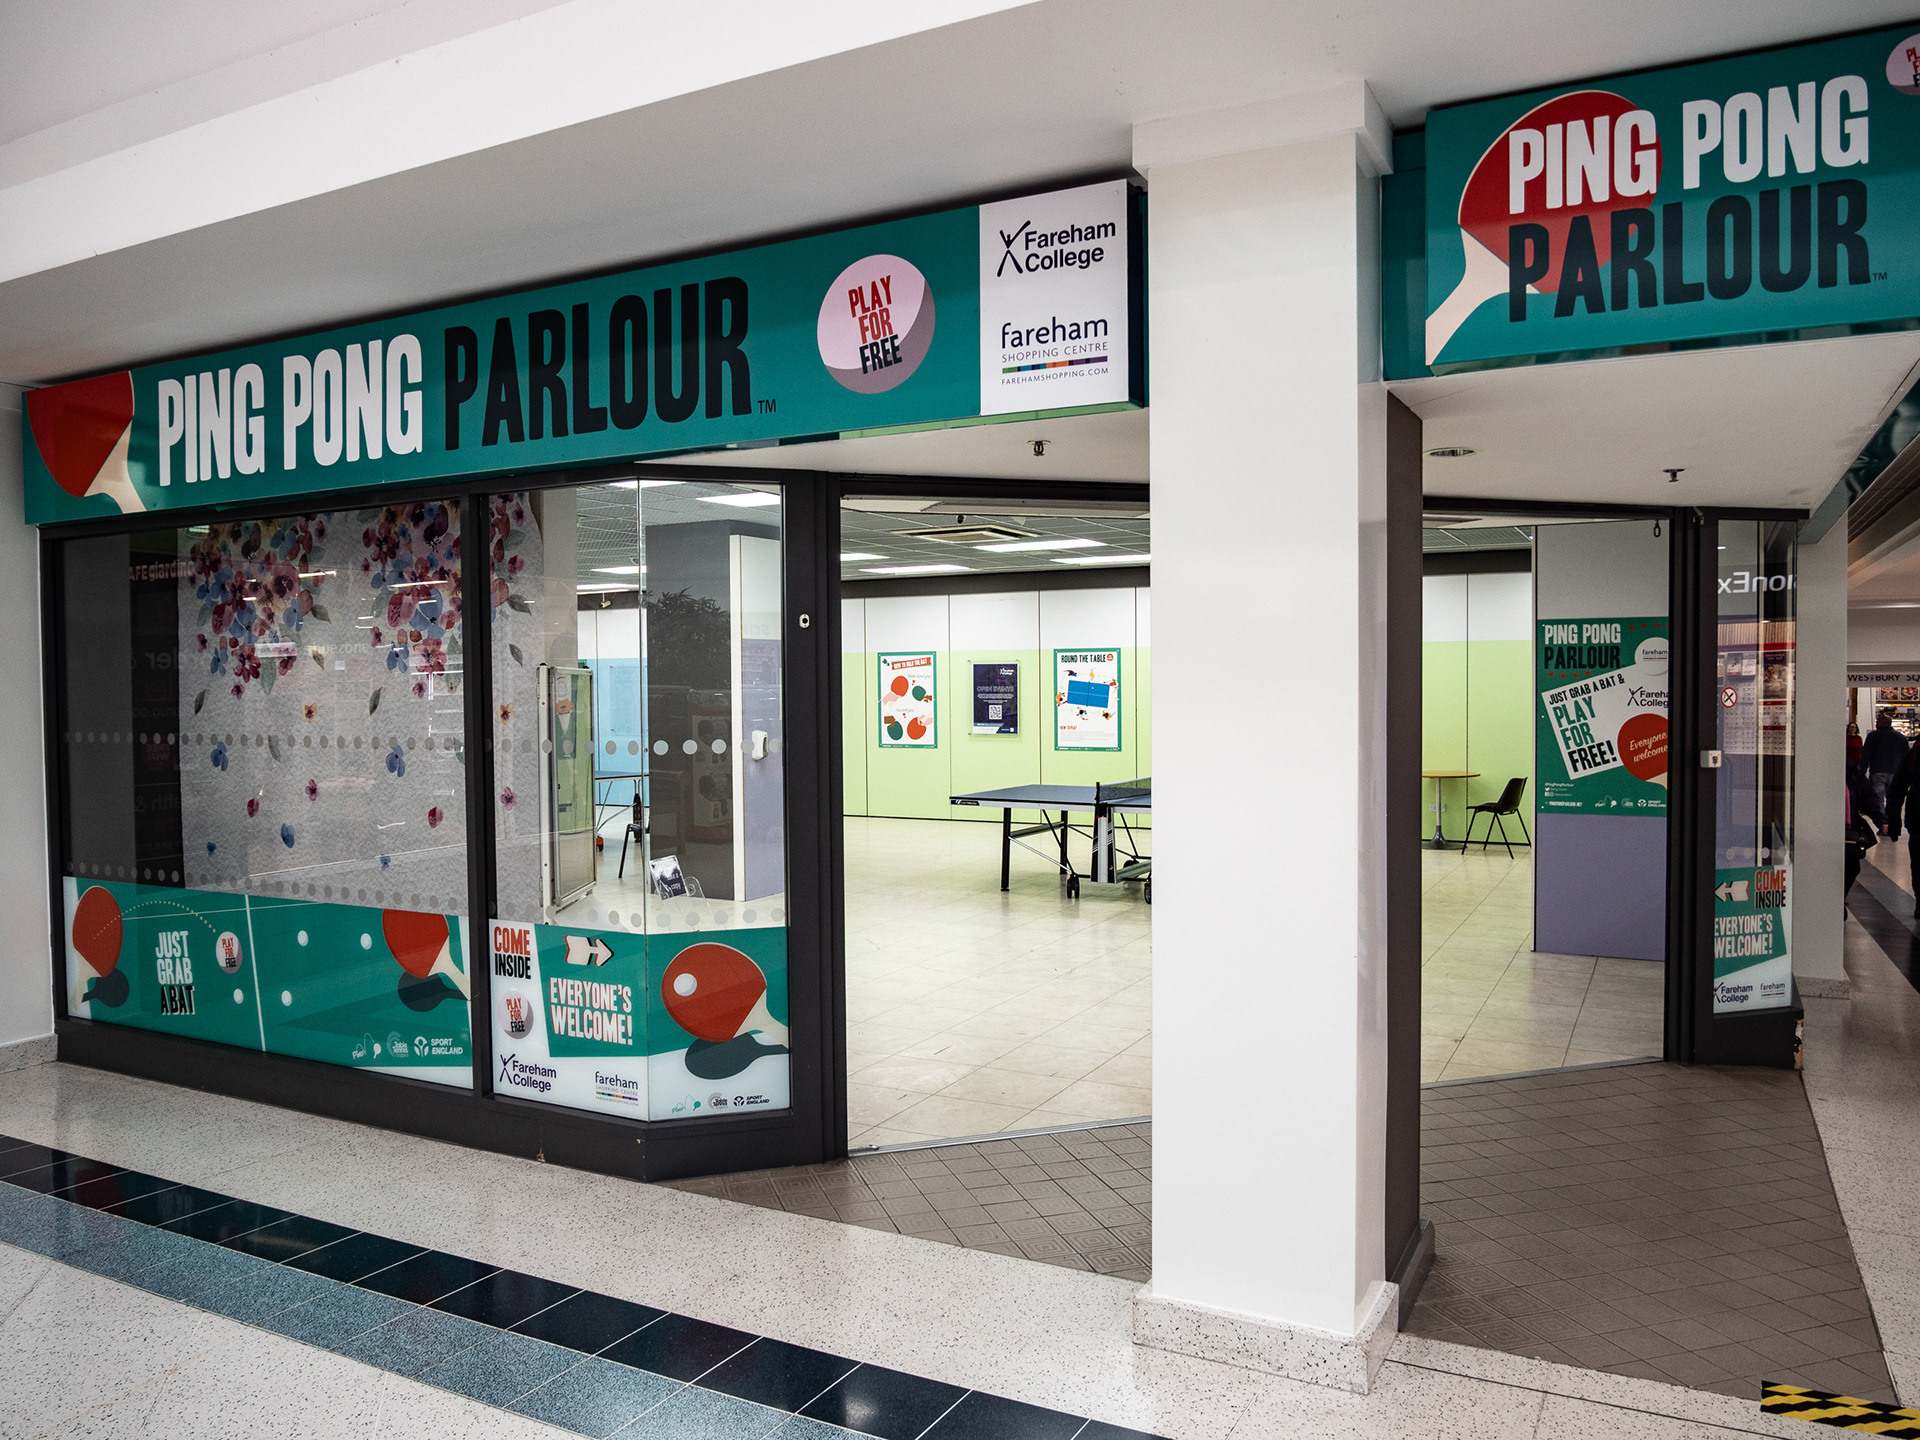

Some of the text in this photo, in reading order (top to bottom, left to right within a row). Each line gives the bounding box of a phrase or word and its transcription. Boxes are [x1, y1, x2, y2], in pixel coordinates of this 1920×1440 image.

[1509, 74, 1869, 214] PING PONG
[1024, 221, 1116, 250] Fareham
[1025, 247, 1105, 273] College
[1508, 178, 1871, 323] PARLOUR
[848, 275, 892, 318] PLAY
[858, 307, 894, 344] FOR
[1001, 316, 1108, 349] fareham
[859, 334, 903, 374] FREE
[1002, 341, 1108, 363] SHOPPING CENTRE
[158, 363, 265, 487] PING
[282, 333, 424, 472] PONG
[444, 276, 752, 451] PARLOUR
[1001, 366, 1109, 386] FAREHAMSHOPPING.COM
[1544, 623, 1621, 645] PING PONG
[1061, 653, 1106, 663] ROUND THE TABLE
[1544, 645, 1620, 669] PARLOUR
[1549, 673, 1625, 705] JUST GRAB A BAT &
[1552, 696, 1596, 728] PLAY
[1560, 722, 1595, 750] FOR
[1629, 732, 1668, 751] Everyone
[1567, 739, 1617, 773] FREE!
[1633, 745, 1668, 762] welcome
[1755, 869, 1786, 891] COME
[1755, 890, 1786, 909] INSIDE
[1714, 913, 1773, 936] EVERYONE'S
[155, 930, 188, 958] JUST
[221, 937, 234, 949] PLAY
[494, 926, 531, 956] COME
[1714, 933, 1773, 959] WELCOME!
[224, 947, 234, 958] FOR
[225, 957, 237, 968] FREE
[156, 957, 193, 985] GRAB
[494, 953, 532, 980] INSIDE
[549, 977, 632, 1013] EVERYONE'S
[1720, 984, 1753, 994] Fareham
[1760, 982, 1786, 991] fareham
[161, 985, 196, 1016] A BAT
[506, 998, 522, 1010] PLAY
[1720, 994, 1749, 1004] College
[509, 1009, 523, 1021] FOR
[549, 1004, 633, 1046] WELCOME!
[510, 1020, 526, 1033] FREE
[430, 1038, 453, 1046] SPORT
[431, 1046, 464, 1055] ENGLAND
[512, 1060, 557, 1078] Fareham
[512, 1074, 552, 1092] College
[594, 1071, 639, 1090] fareham
[595, 1085, 639, 1097] SHOPPING CENTRE
